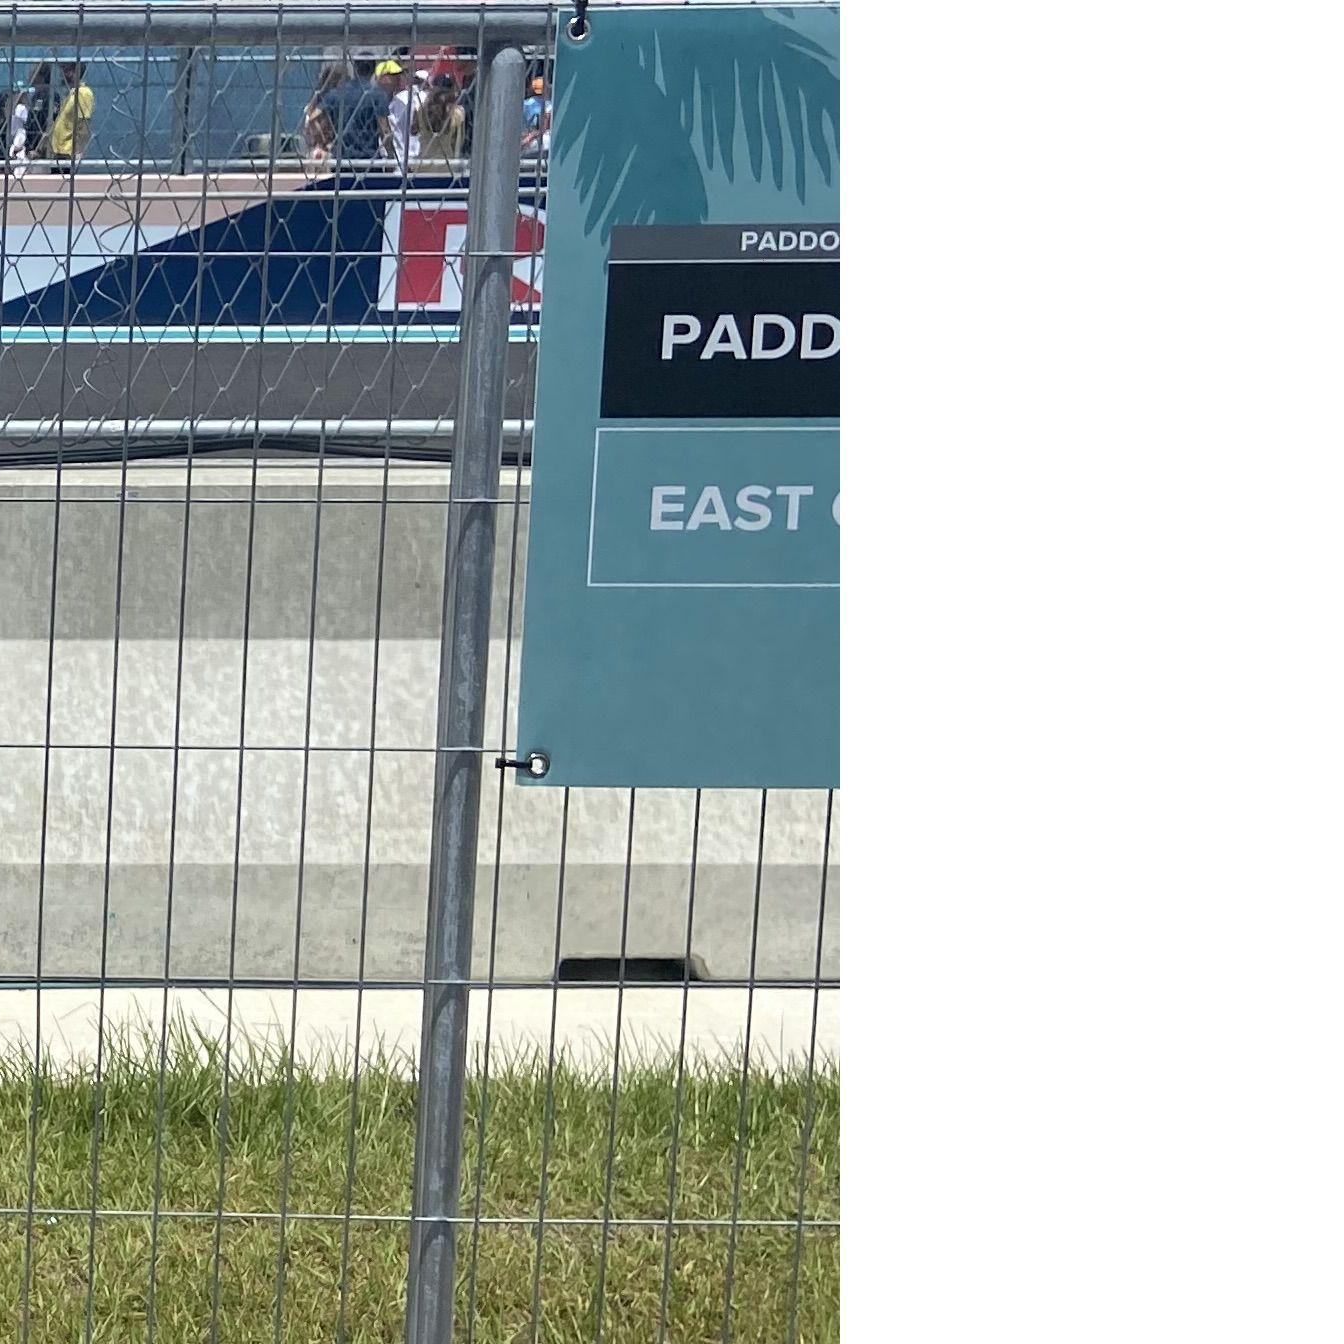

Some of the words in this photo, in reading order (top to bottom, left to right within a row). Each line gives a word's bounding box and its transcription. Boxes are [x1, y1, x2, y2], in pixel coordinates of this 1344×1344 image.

[740, 230, 840, 252] PADDO
[661, 313, 840, 360] PADD
[649, 484, 814, 532] EAST
